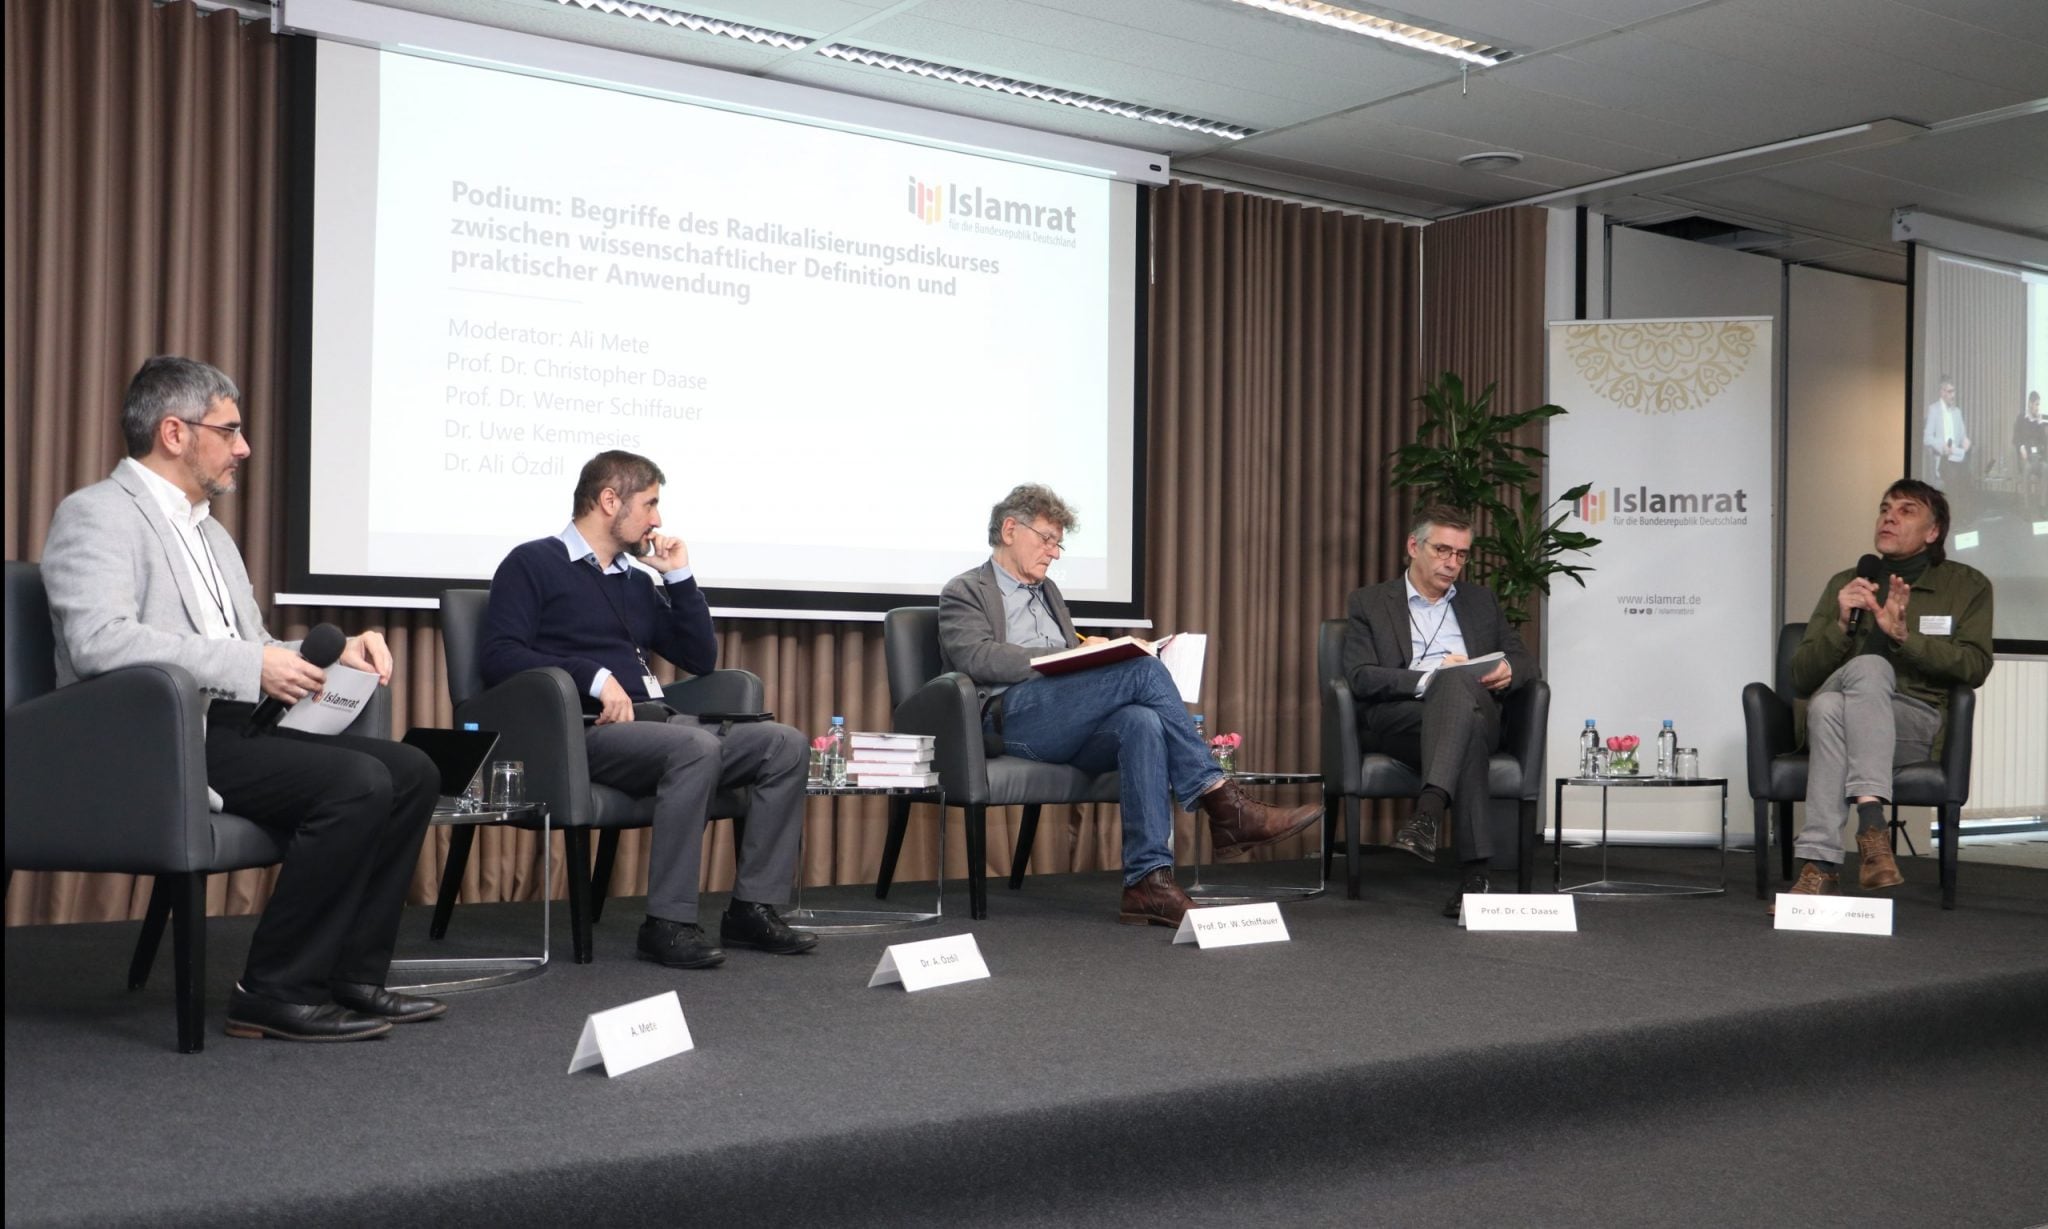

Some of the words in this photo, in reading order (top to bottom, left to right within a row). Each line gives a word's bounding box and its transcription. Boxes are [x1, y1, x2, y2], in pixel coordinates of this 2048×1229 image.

[949, 183, 1076, 233] Islamrat
[452, 180, 562, 216] Podium:
[571, 197, 670, 231] Begriffe
[678, 212, 718, 236] des
[726, 218, 999, 274] Radikalisierungsdiskurses
[961, 221, 973, 233] die
[975, 222, 1031, 241] Bundesrepublik
[1033, 231, 1076, 248] Deutschland
[451, 217, 570, 248] zwischen
[579, 231, 797, 276] wissenschaftlicher
[804, 257, 910, 291] Definition
[917, 277, 956, 296] und
[451, 249, 598, 282] praktischer
[605, 263, 751, 305] Anwendung
[448, 318, 563, 347] Moderator:
[569, 330, 593, 349] Ali
[600, 333, 649, 354] Mete
[447, 352, 493, 373] Prof.
[501, 356, 527, 376] Dr.
[534, 358, 647, 387] Christopher
[653, 369, 708, 390] Daase
[445, 386, 491, 406] Prof.
[499, 389, 526, 408] Dr.
[533, 391, 604, 414] Werner
[610, 397, 703, 420] Schiffauer
[444, 419, 471, 439] Dr.
[480, 421, 525, 441] Uwe
[533, 424, 641, 448] Kemmesies
[444, 453, 471, 472] Dr.
[478, 454, 503, 473] Ali
[511, 451, 565, 476] Özdil
[1614, 486, 1748, 513] Islamrat
[1614, 516, 1624, 526] für
[1626, 516, 1638, 526] die
[1640, 516, 1697, 528] Bundesrepublik
[1699, 516, 1748, 526] Deutschland
[1617, 594, 1702, 605] www.islamrat.de
[323, 691, 360, 709] Islamrat
[1241, 917, 1278, 927] Schiffauer
[1531, 907, 1559, 915] Daase
